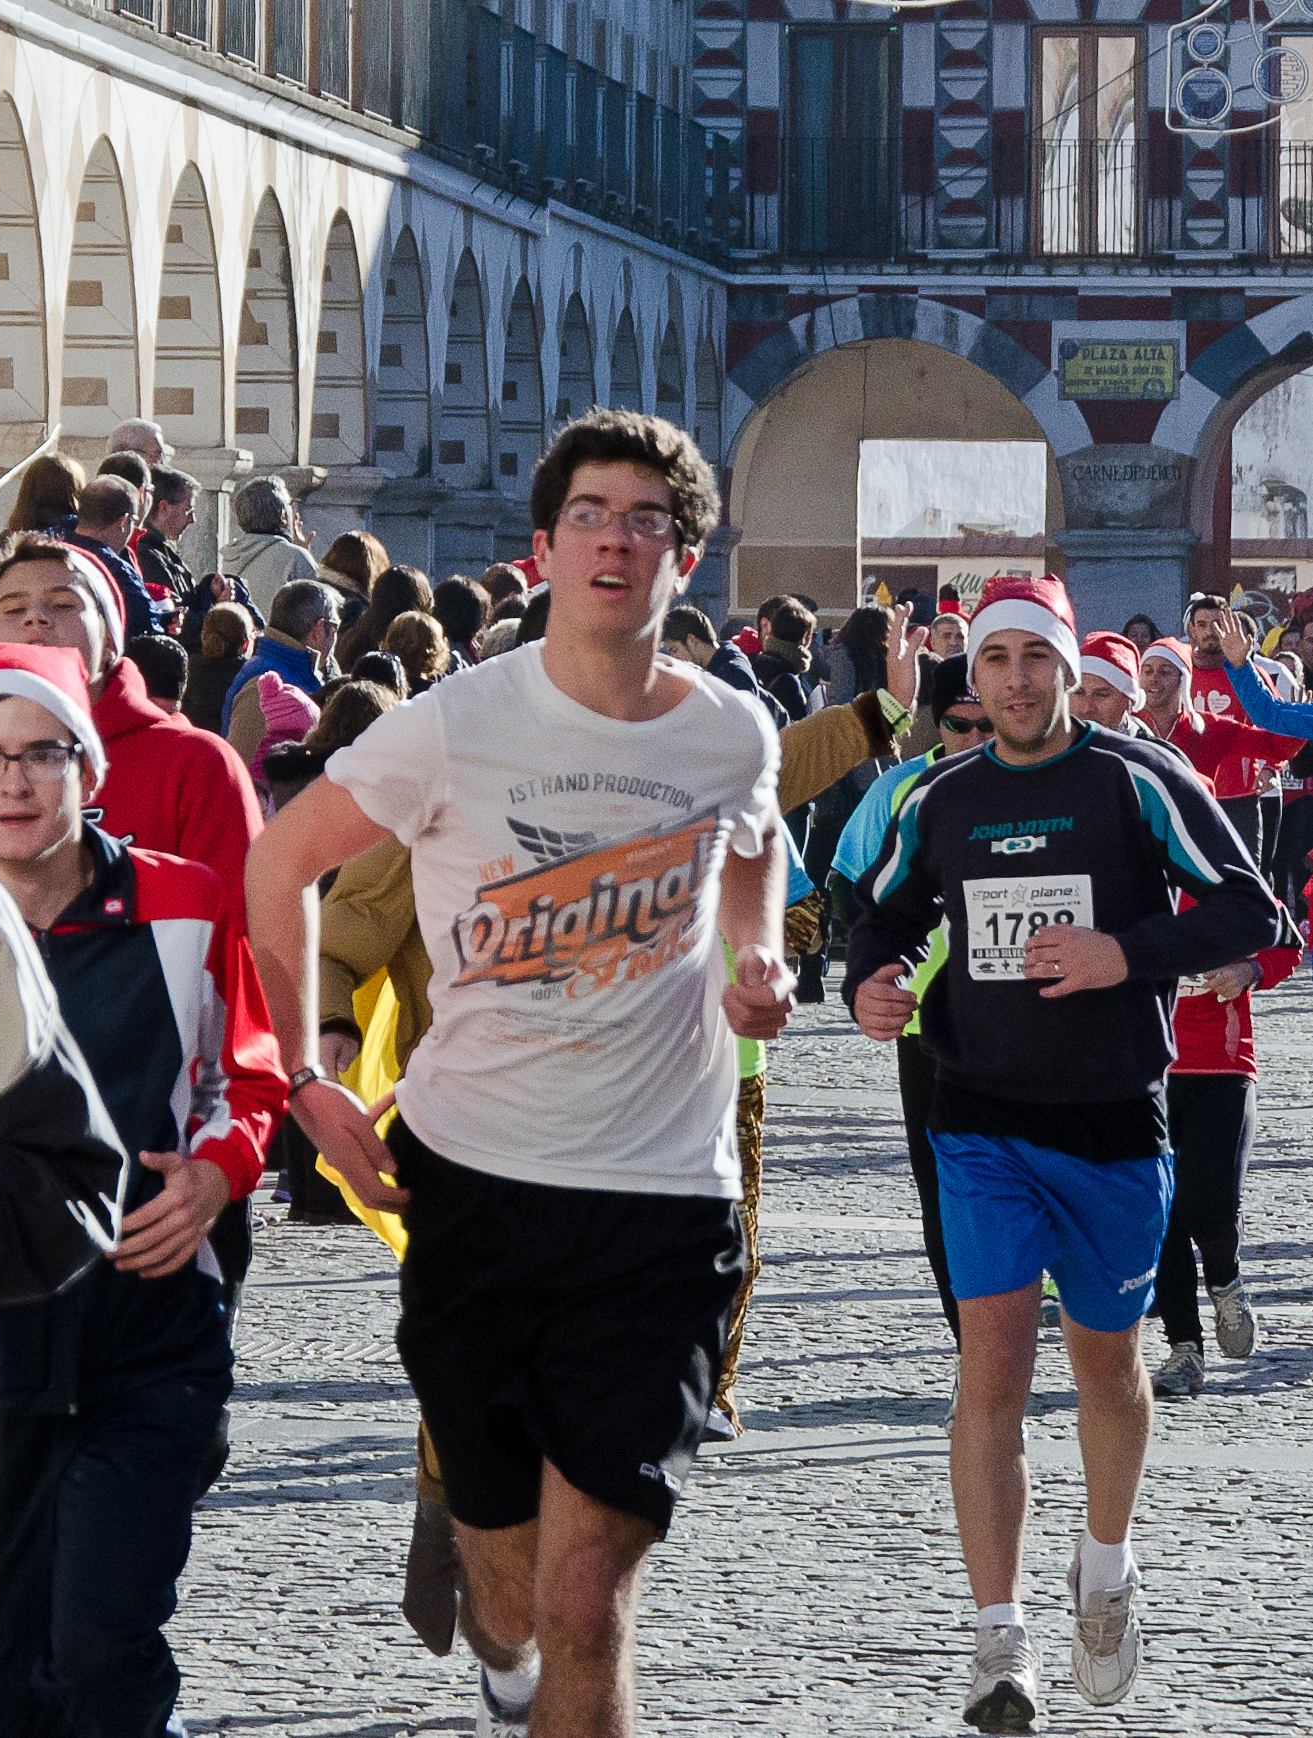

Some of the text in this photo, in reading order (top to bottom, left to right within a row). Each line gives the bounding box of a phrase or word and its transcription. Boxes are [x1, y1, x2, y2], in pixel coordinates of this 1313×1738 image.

[1081, 347, 1166, 361] PLAZA ALTA
[539, 772, 589, 796] HAND
[593, 772, 695, 811] PRODUCTION
[1015, 816, 1074, 836] SMITH
[477, 854, 515, 884] NEW
[451, 833, 712, 970] Original
